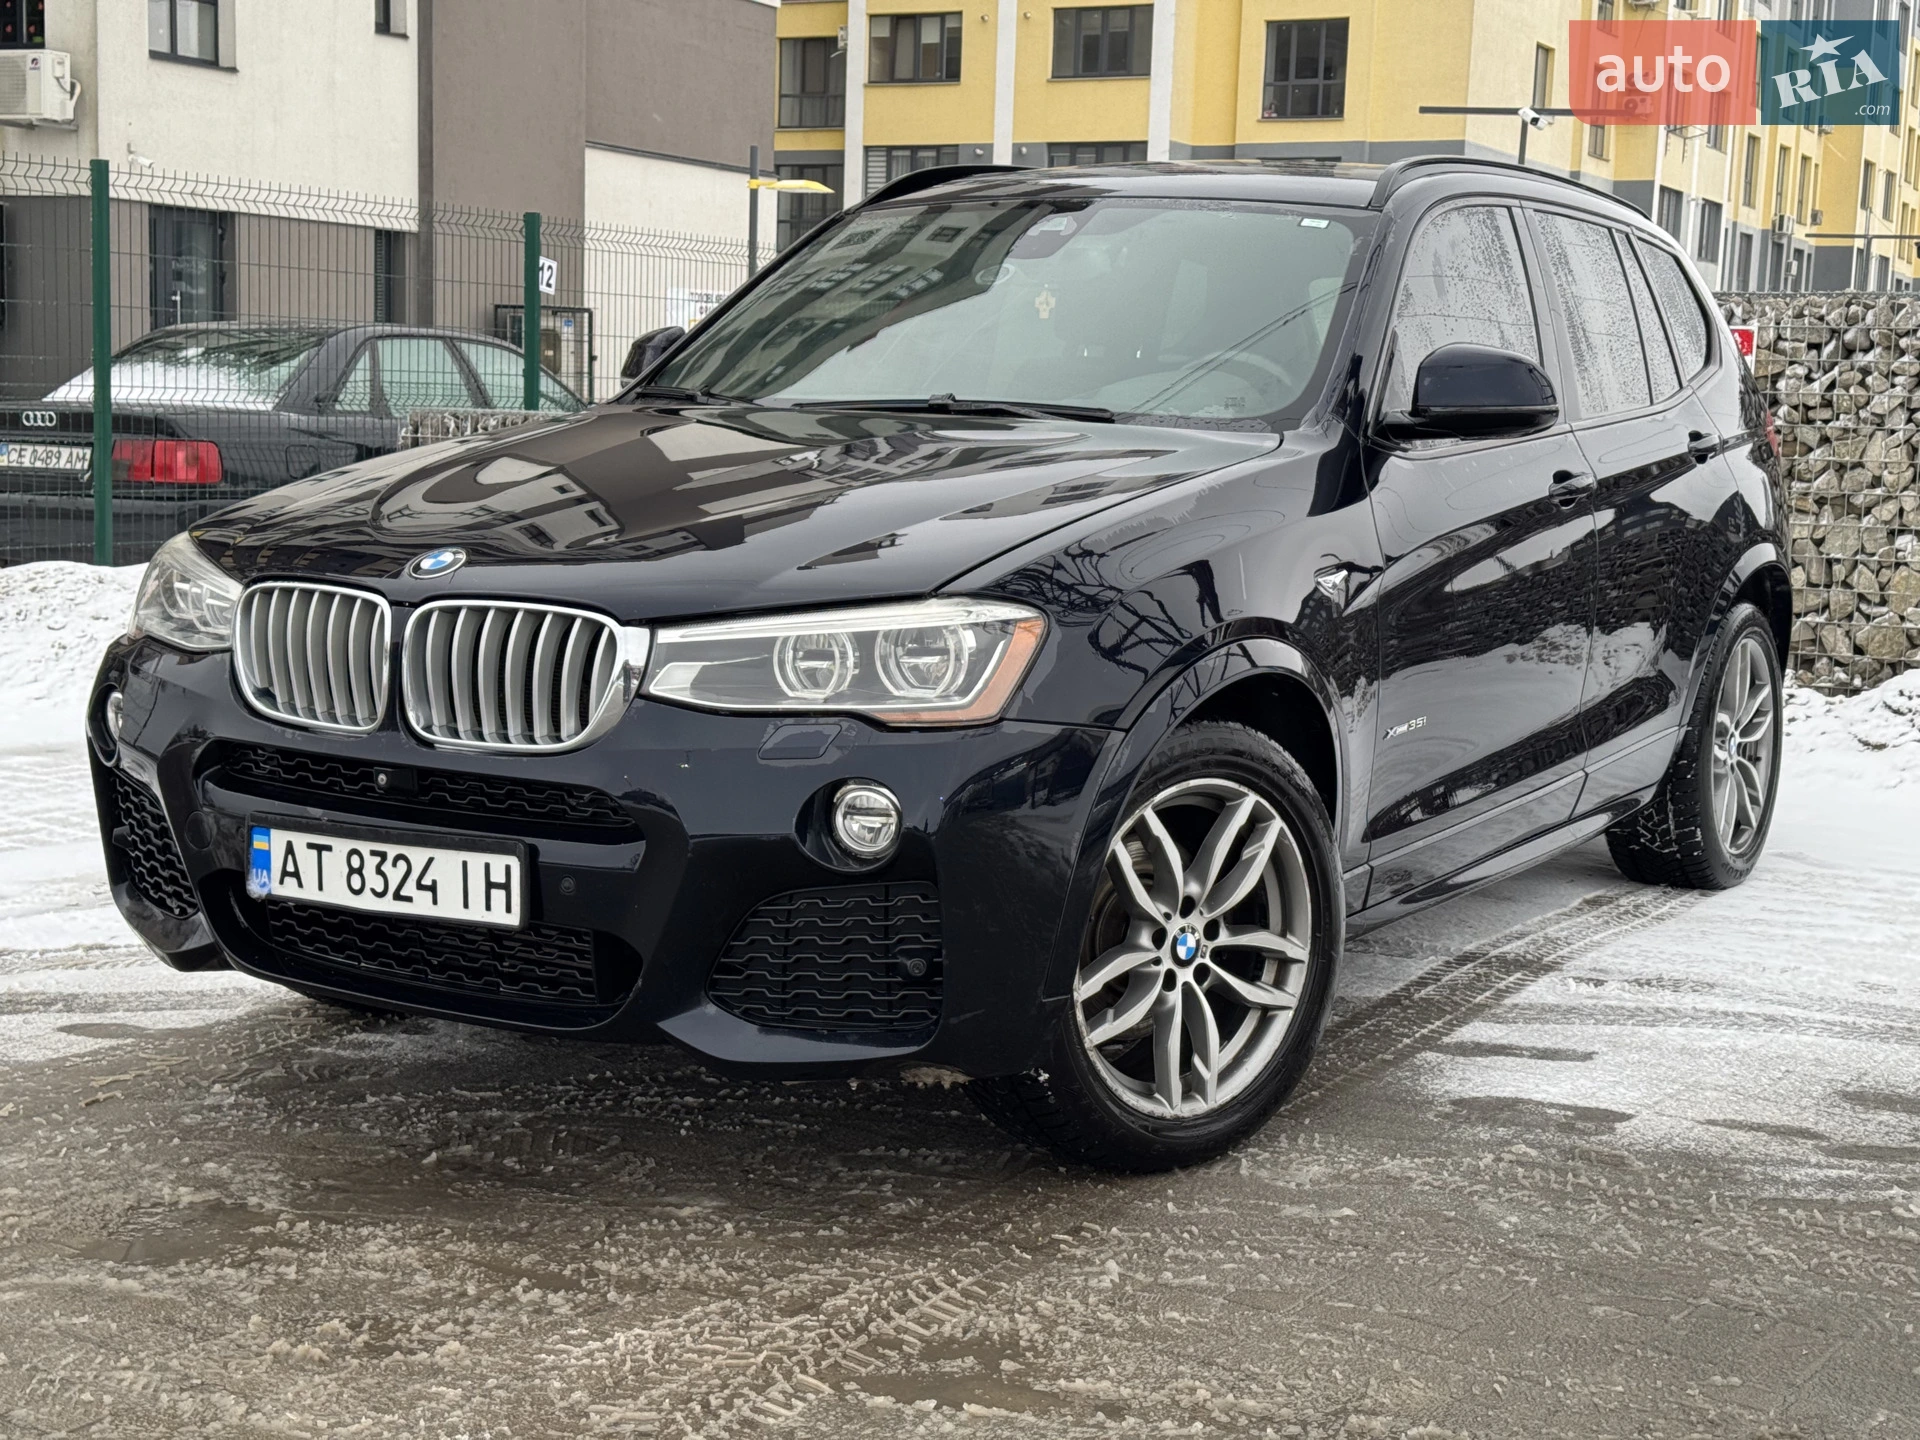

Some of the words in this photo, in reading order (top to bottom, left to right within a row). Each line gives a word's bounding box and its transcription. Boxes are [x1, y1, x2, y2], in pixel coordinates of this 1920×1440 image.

[8, 447, 28, 465] CE
[252, 868, 270, 885] UA
[278, 839, 333, 892] AT
[346, 848, 438, 906] 8324
[462, 859, 512, 914] IH
